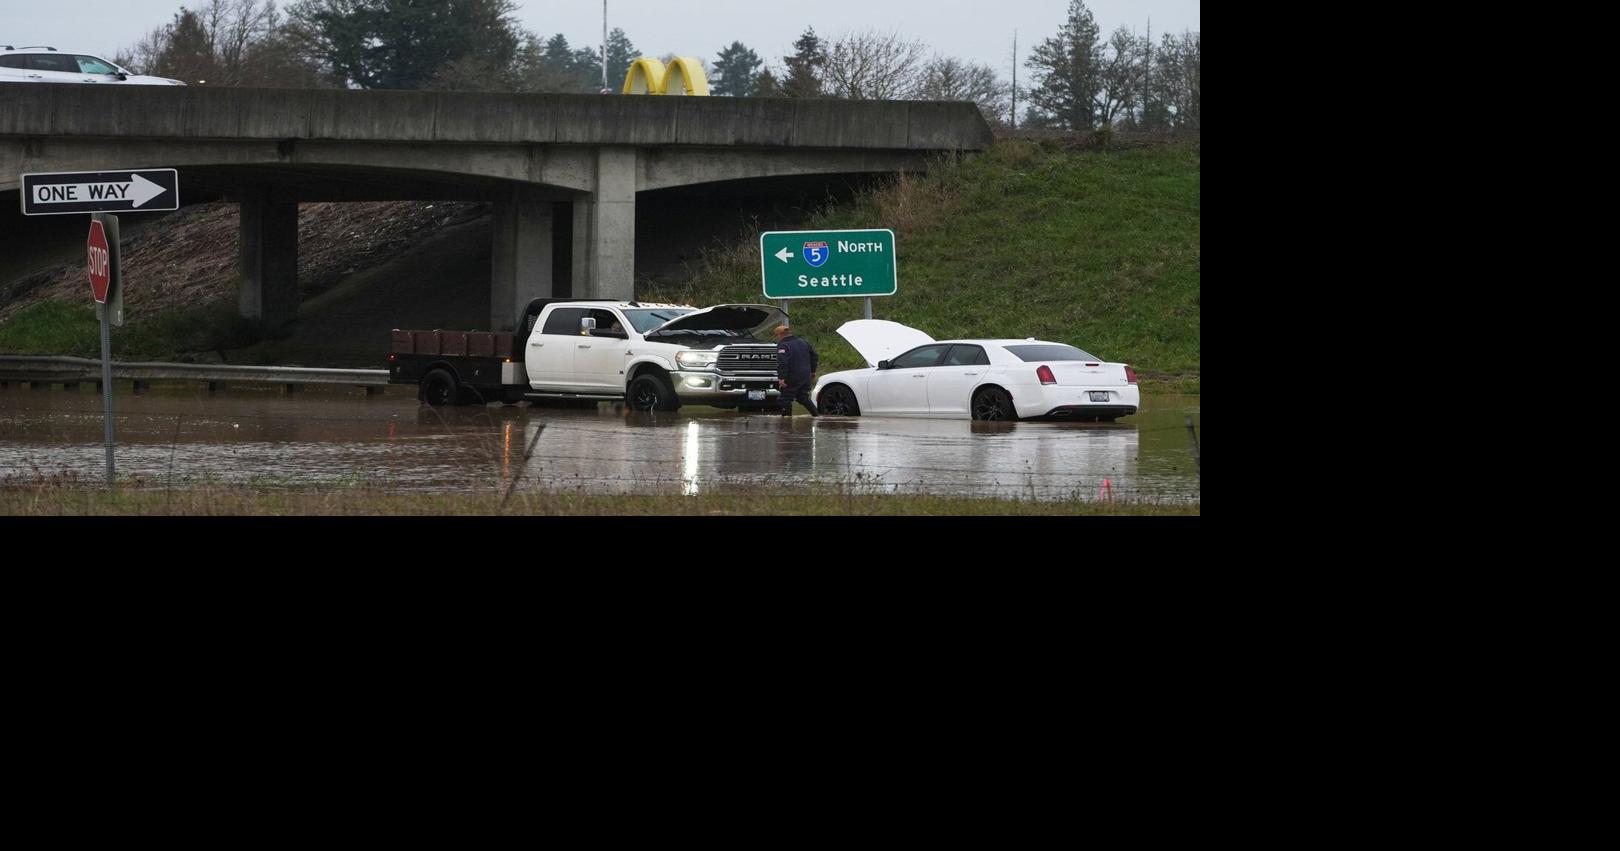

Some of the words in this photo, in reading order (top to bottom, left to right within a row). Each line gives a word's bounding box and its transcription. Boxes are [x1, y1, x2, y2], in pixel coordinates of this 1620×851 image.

[38, 185, 78, 202] ONE
[88, 183, 130, 200] WAY
[89, 245, 108, 277] STOP
[811, 248, 821, 262] 5
[797, 274, 863, 287] Seattle
